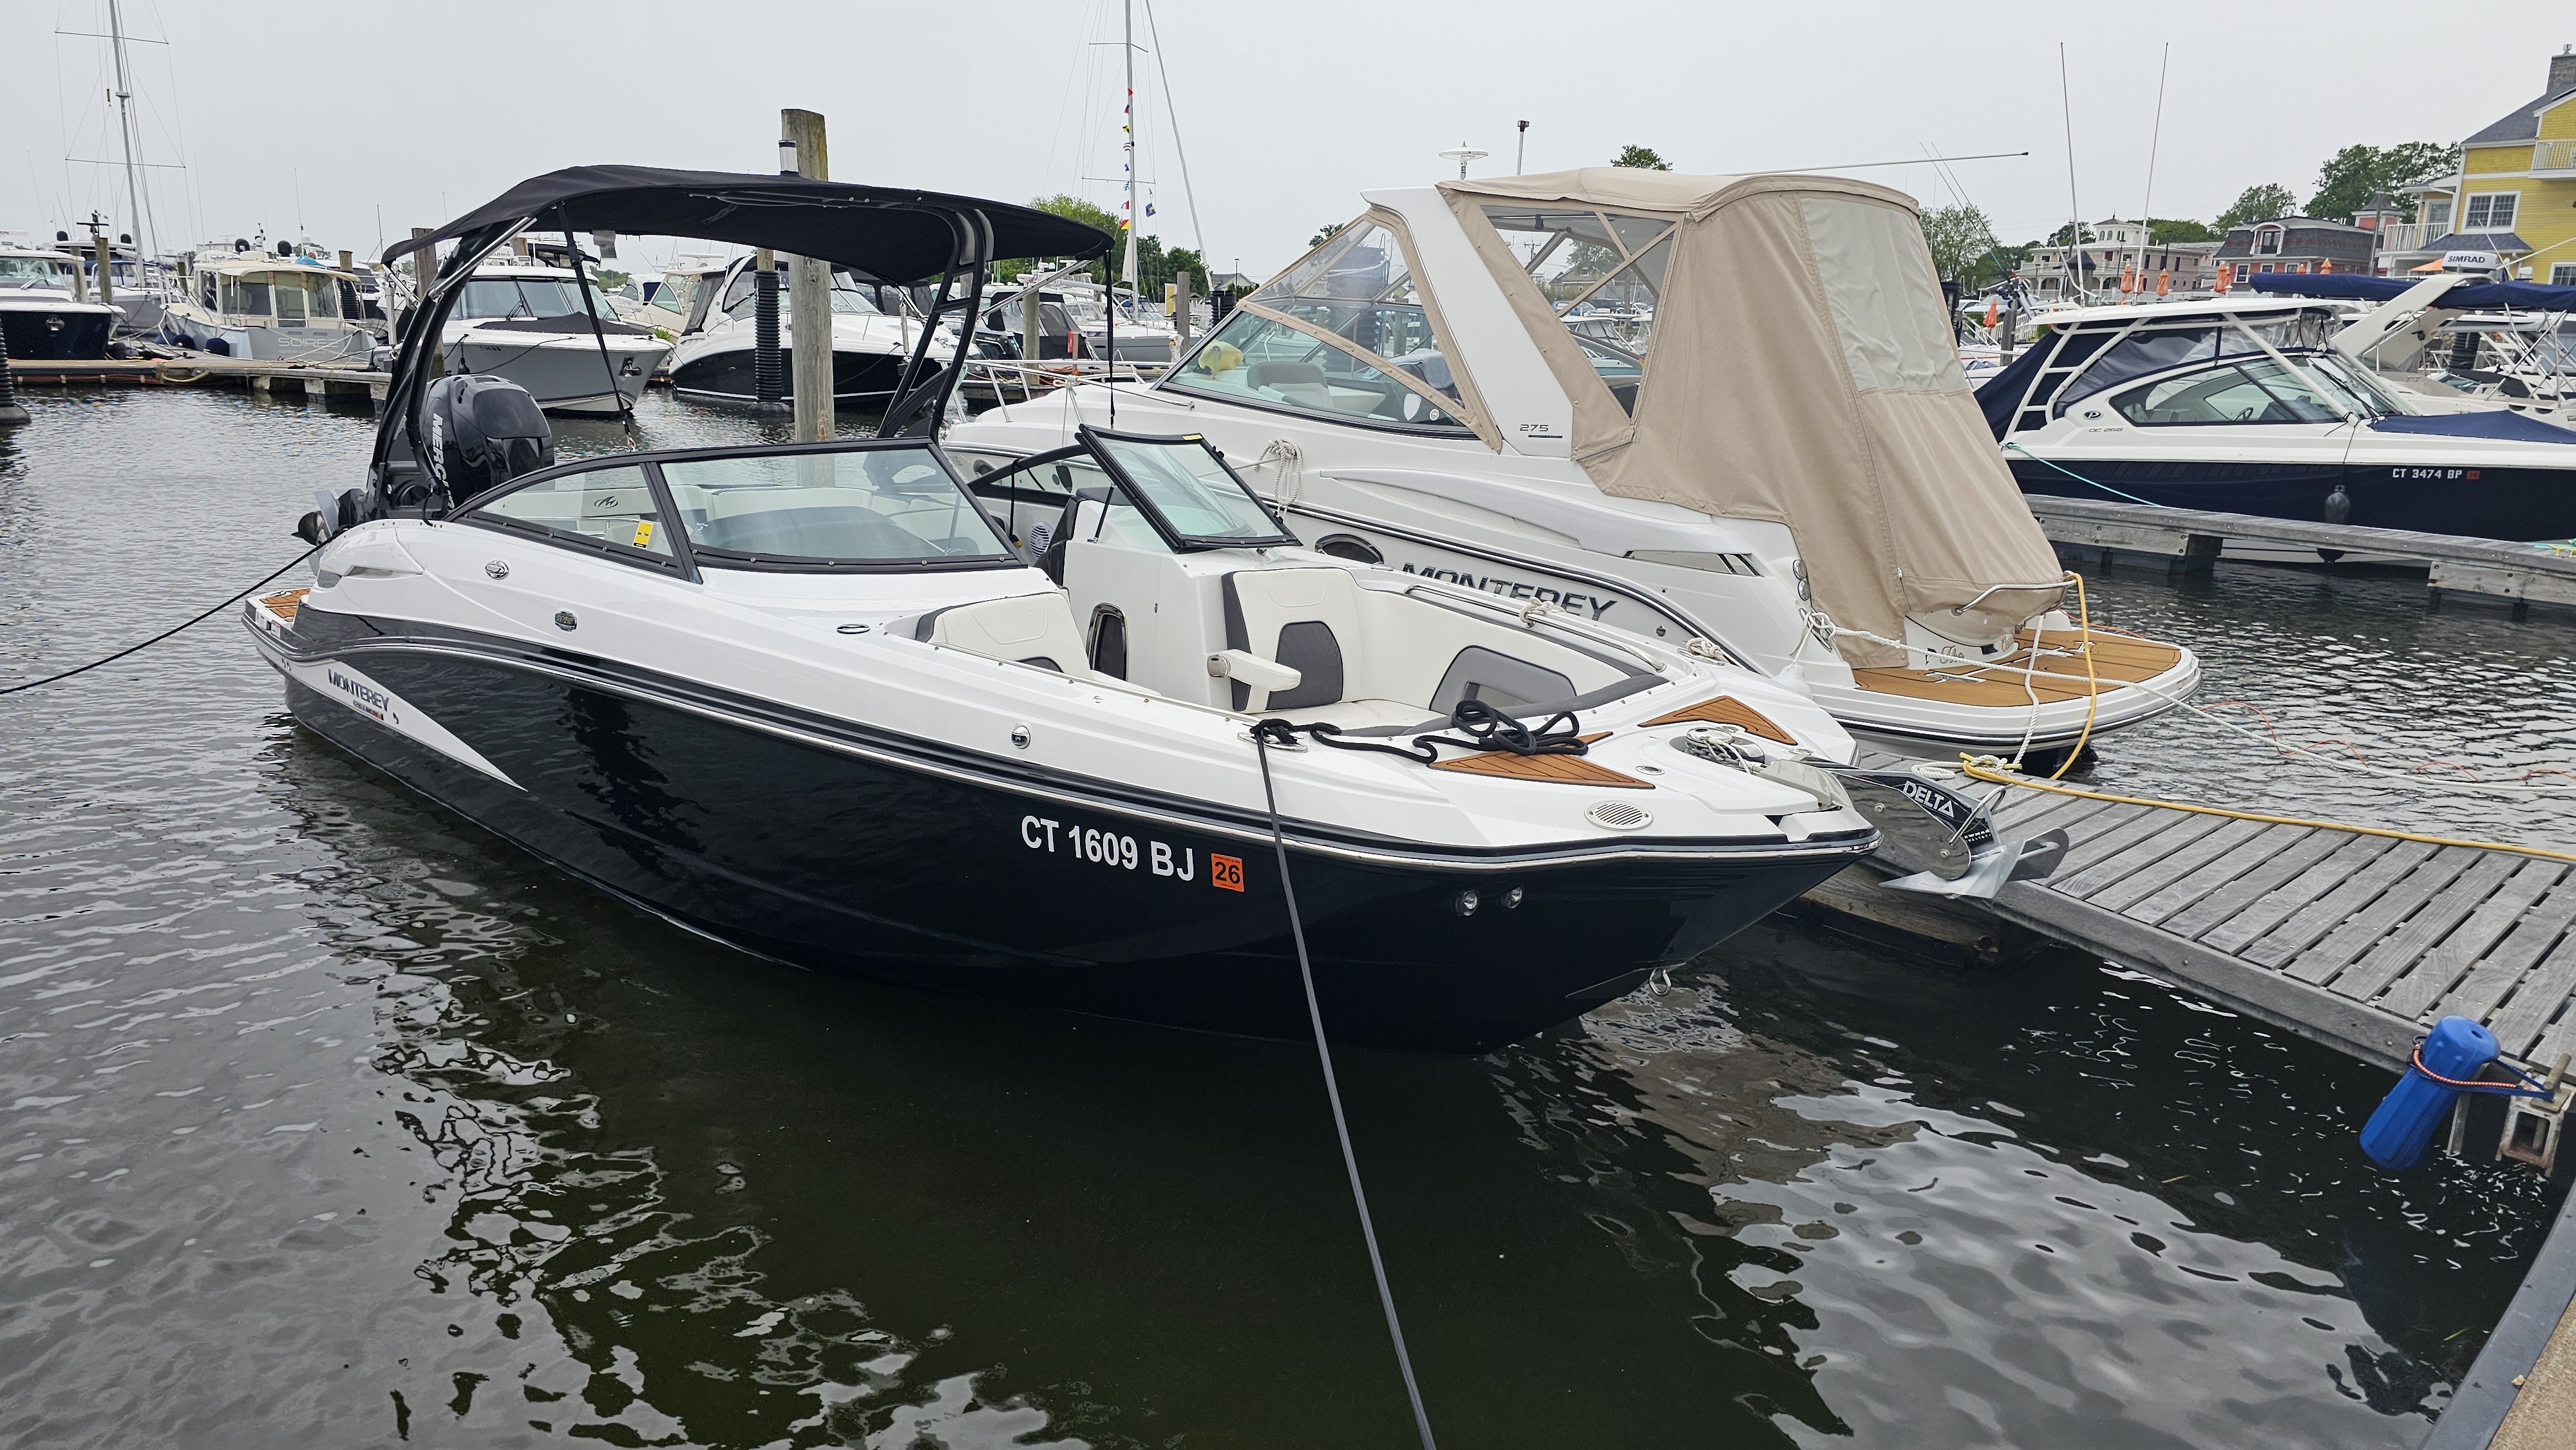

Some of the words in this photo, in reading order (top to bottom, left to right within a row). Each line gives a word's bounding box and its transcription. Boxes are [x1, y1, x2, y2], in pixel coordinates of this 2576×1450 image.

[278, 337, 339, 348] SOIREE
[1520, 424, 1549, 432] 275
[2392, 468, 2407, 478] CT
[2412, 469, 2442, 478] 3474
[2447, 469, 2462, 479] BP
[1401, 562, 1618, 621] MONTEREY
[328, 668, 390, 712] MONTEREY
[1902, 780, 1954, 818] DELTA
[1021, 815, 1059, 852] CT
[1068, 825, 1139, 870] 1609
[1150, 840, 1195, 881] BJ
[1215, 861, 1241, 885] 26
